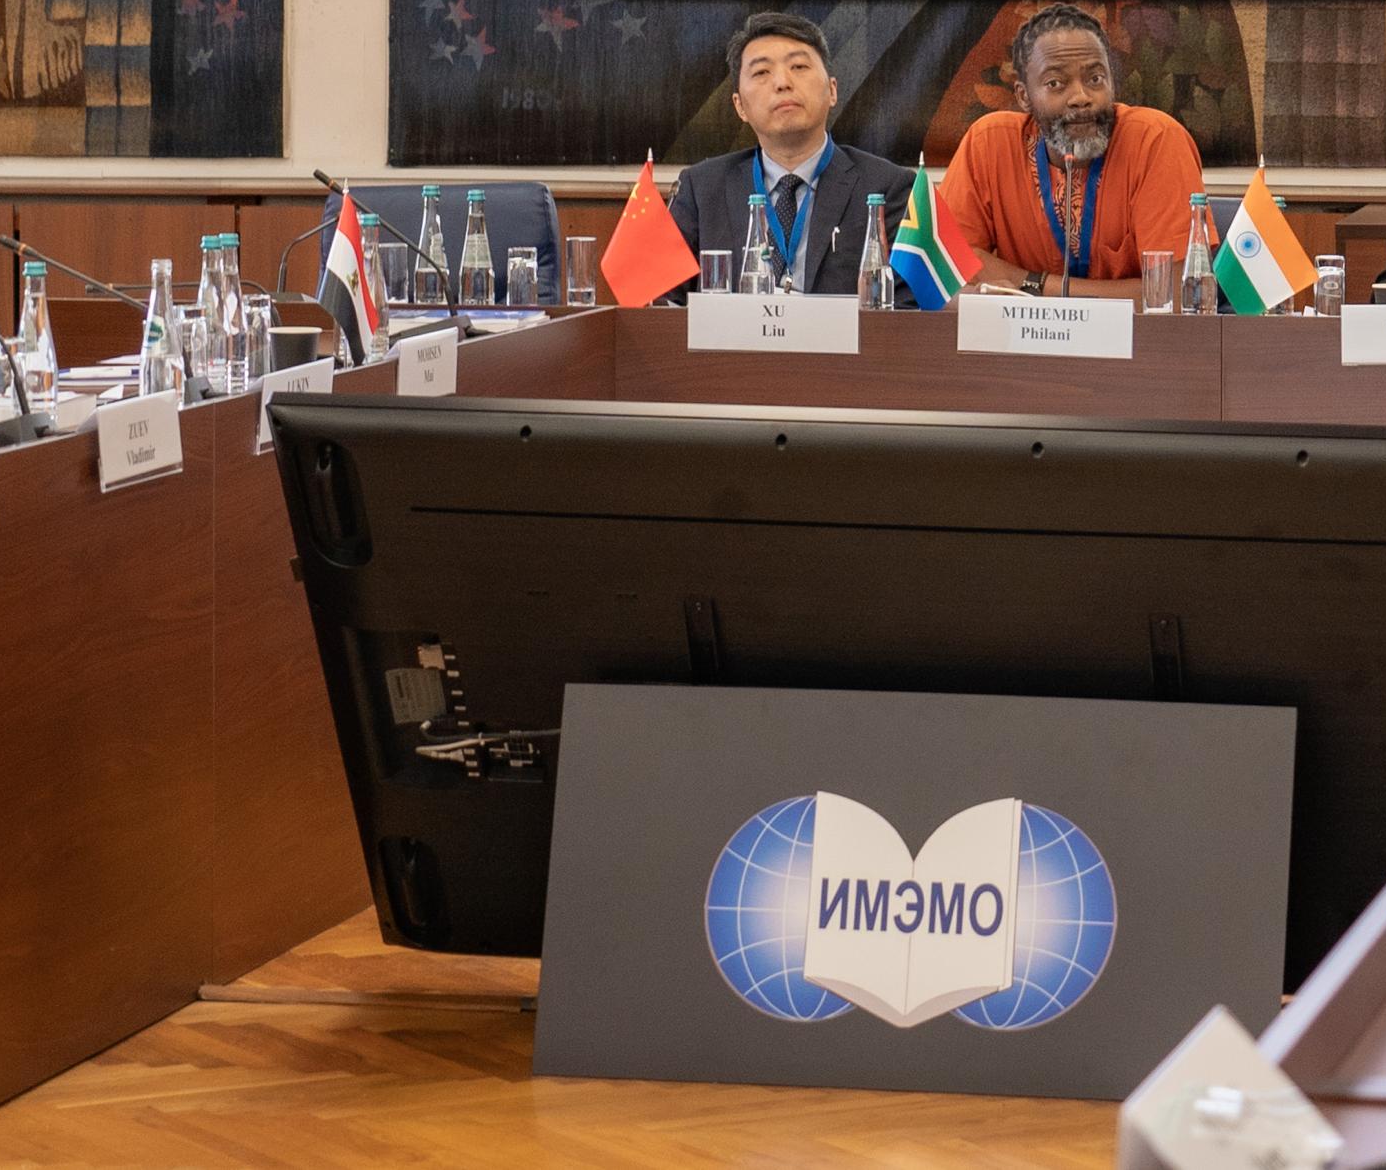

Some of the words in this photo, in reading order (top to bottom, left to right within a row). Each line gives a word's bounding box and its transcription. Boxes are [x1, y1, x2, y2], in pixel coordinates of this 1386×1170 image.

[762, 304, 785, 318] XU
[1001, 305, 1090, 323] MTHEMBU
[762, 324, 786, 337] Liu
[1020, 326, 1071, 341] Philani
[127, 418, 150, 441] ZUEV
[125, 444, 156, 467] Vladimir
[817, 877, 1005, 938] ИМЭМО
